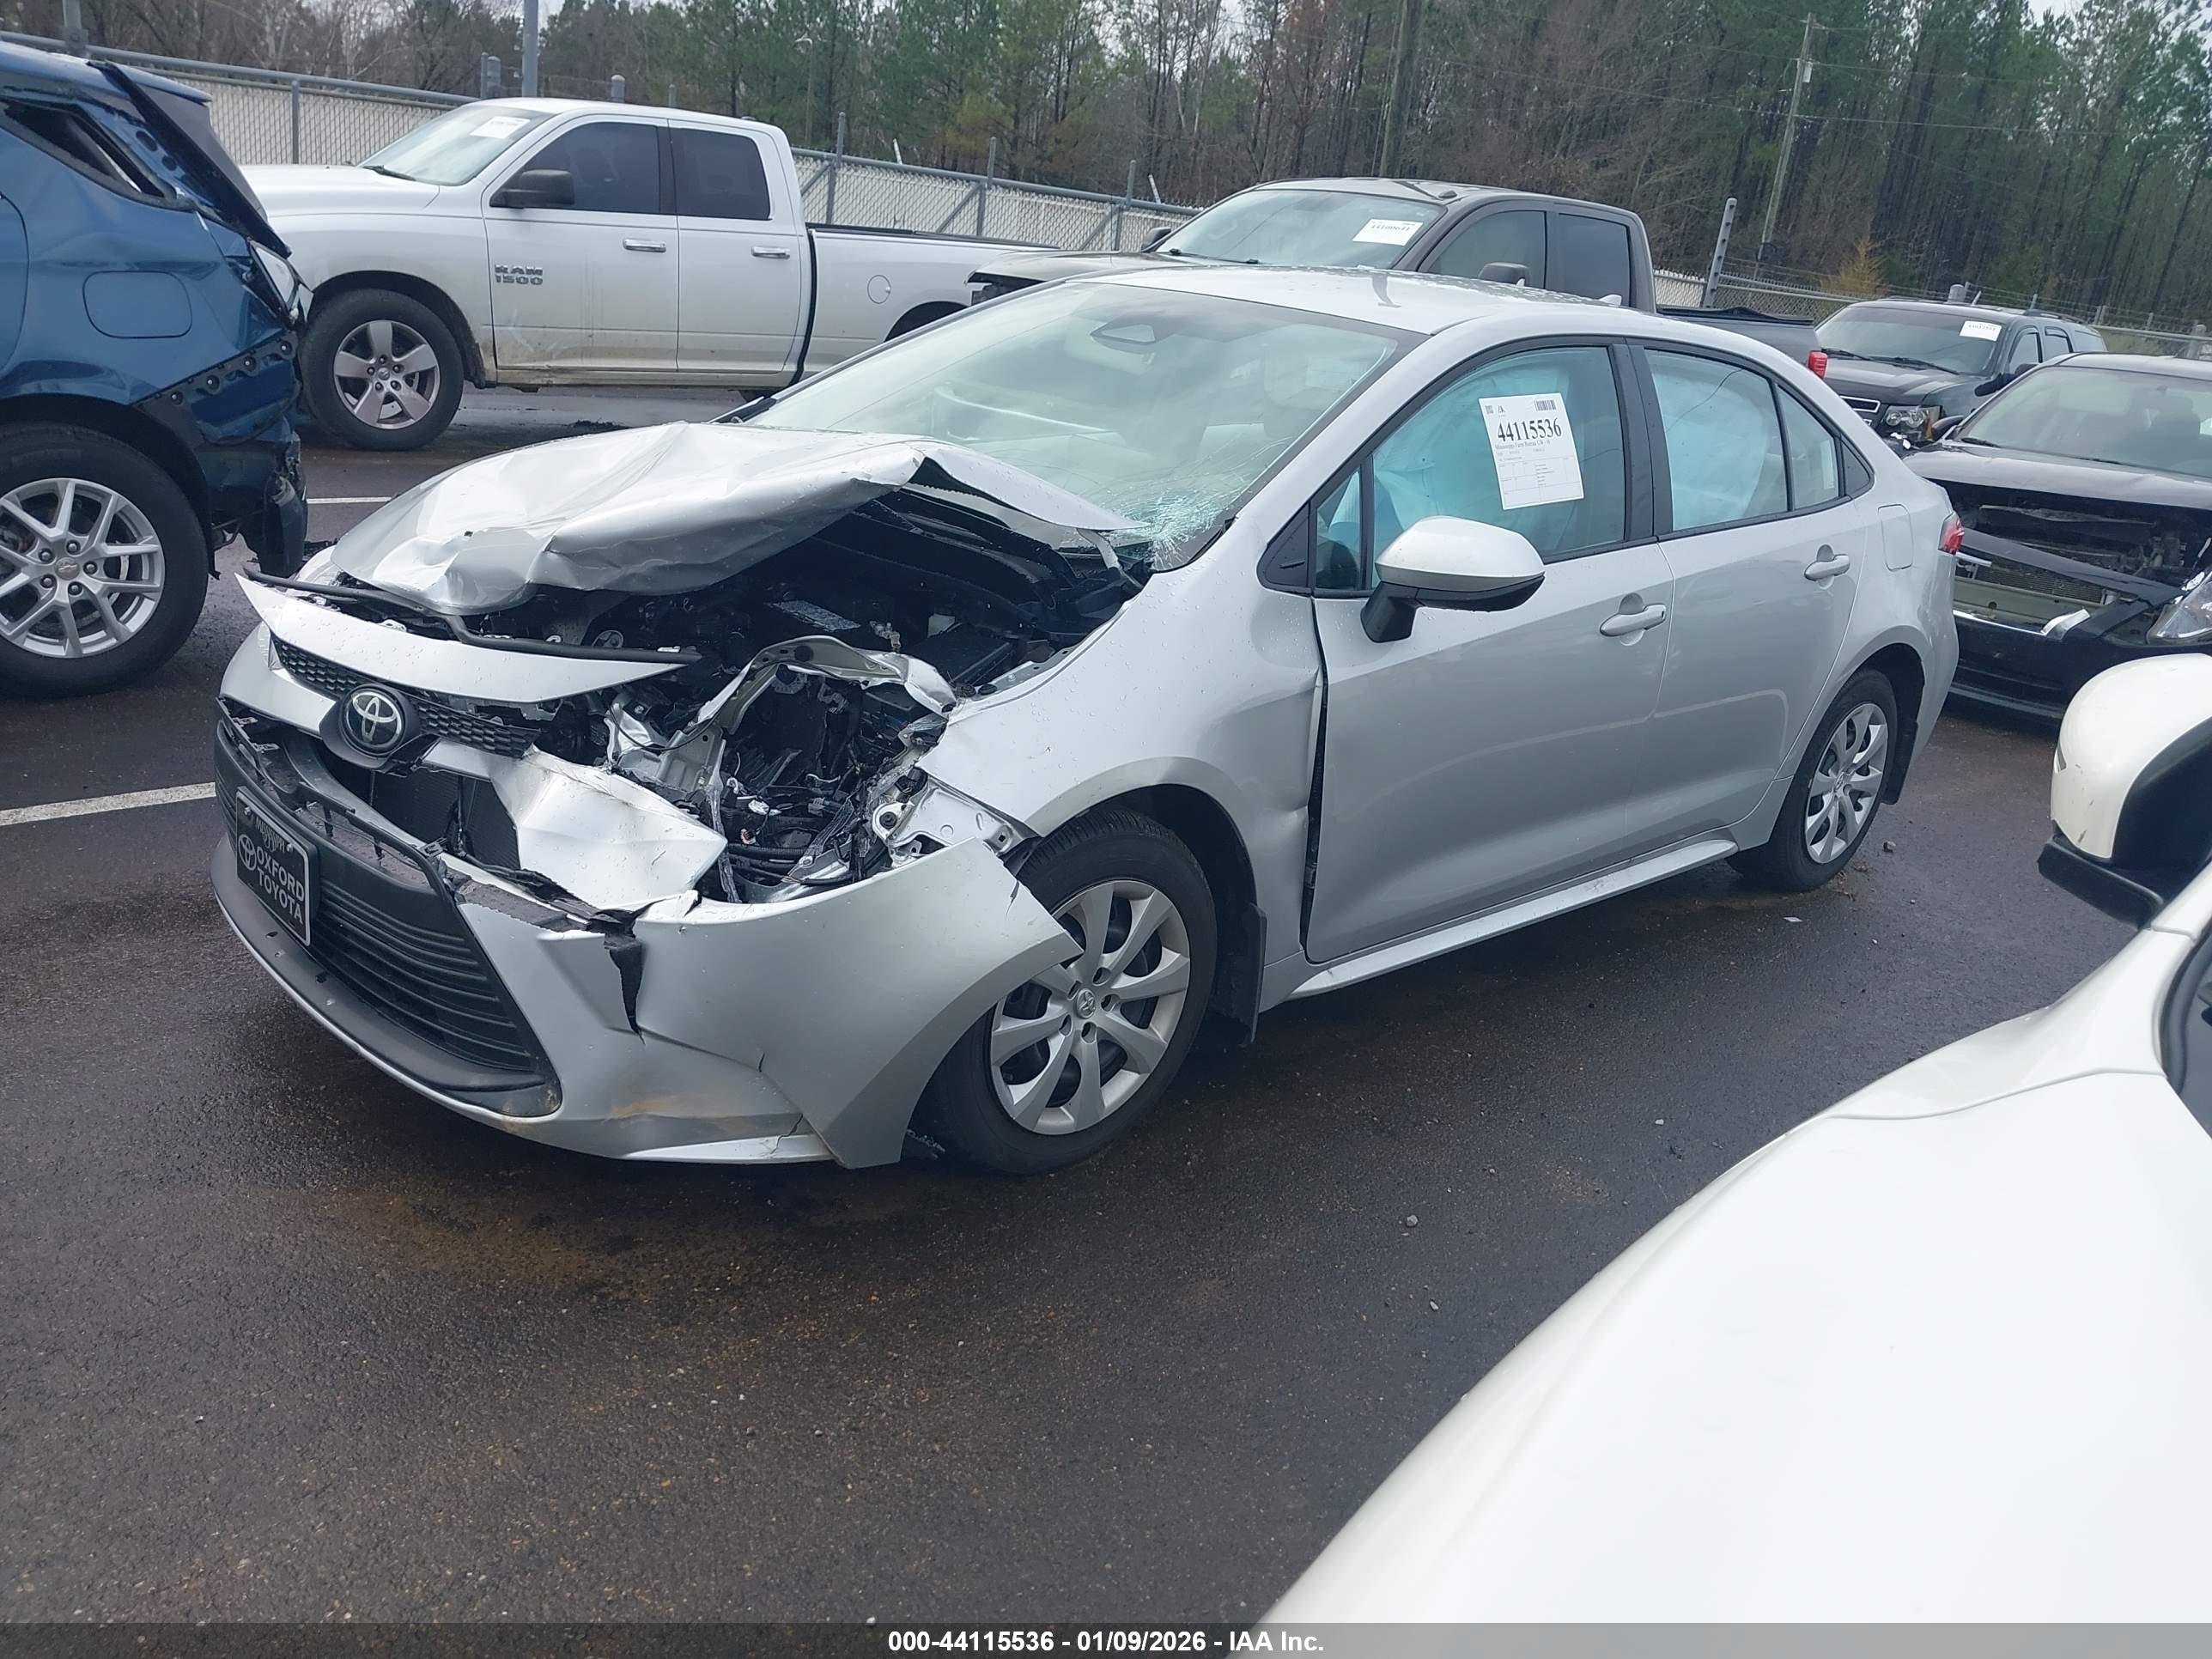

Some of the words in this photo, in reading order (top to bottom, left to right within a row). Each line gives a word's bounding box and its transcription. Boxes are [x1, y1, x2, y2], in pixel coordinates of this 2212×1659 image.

[495, 264, 544, 276] RAM
[495, 274, 544, 285] 1500
[1497, 417, 1562, 442] 44115536
[257, 846, 305, 902] OXFORD
[257, 866, 304, 925] TOYOTA
